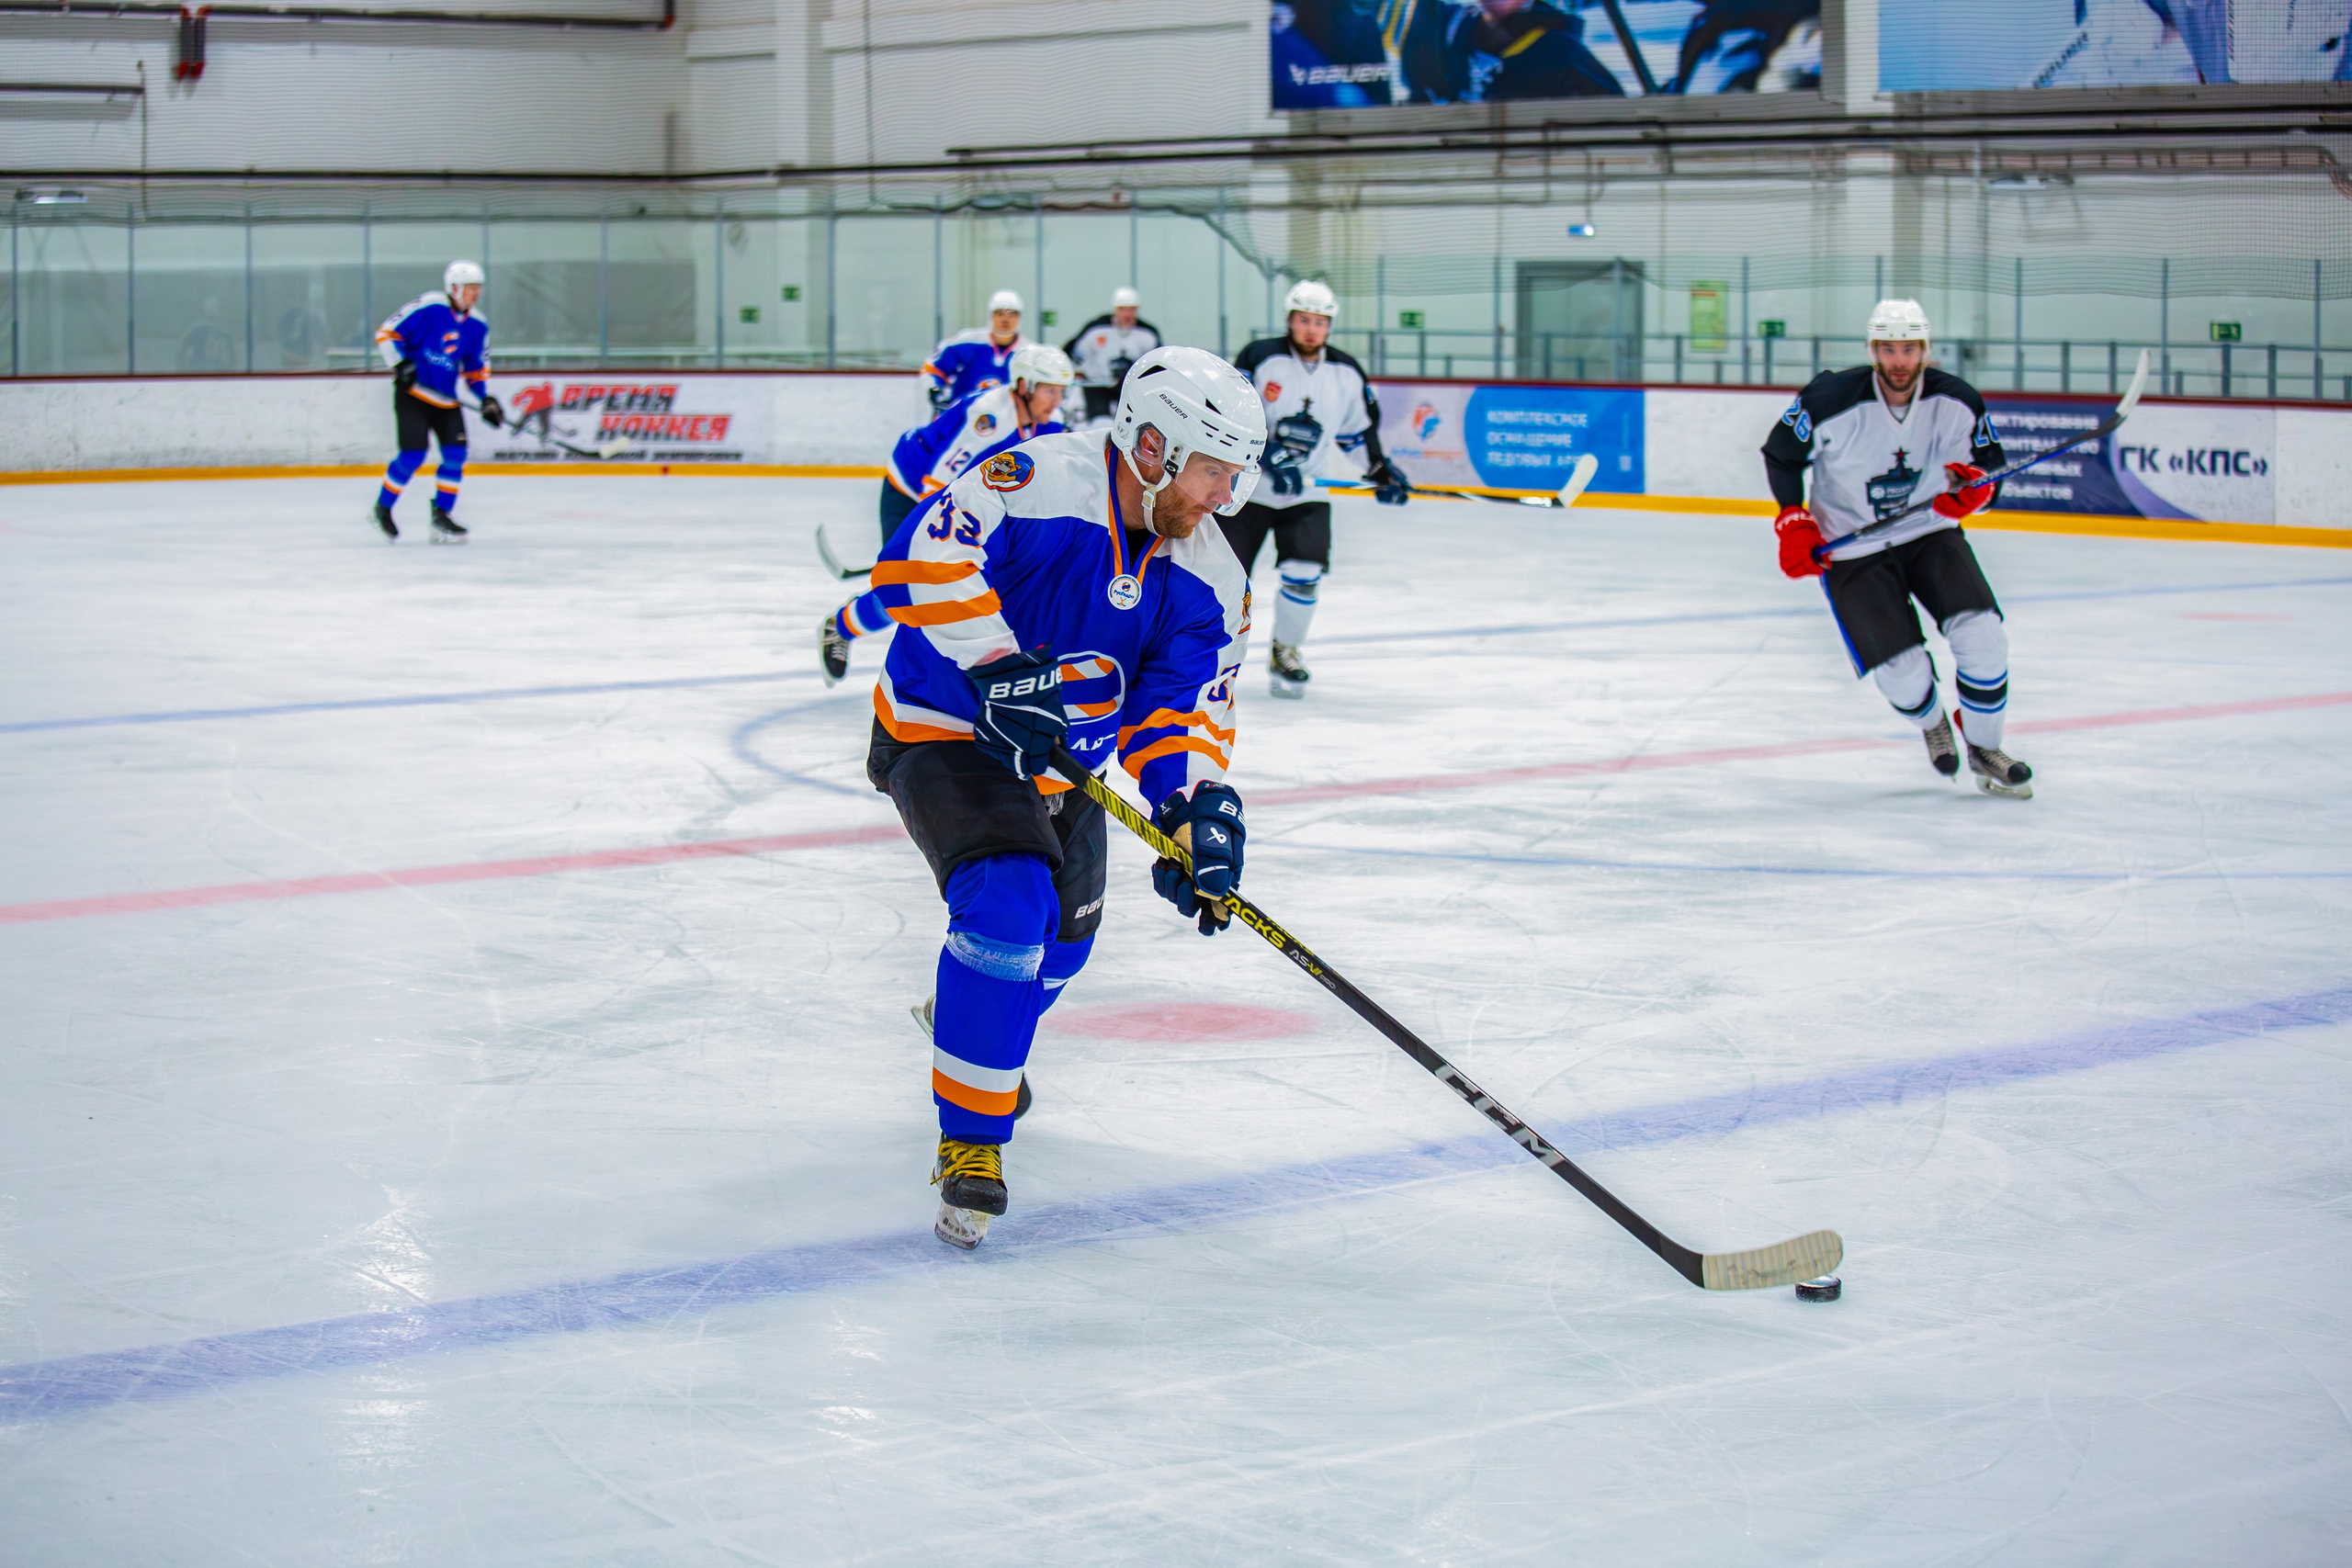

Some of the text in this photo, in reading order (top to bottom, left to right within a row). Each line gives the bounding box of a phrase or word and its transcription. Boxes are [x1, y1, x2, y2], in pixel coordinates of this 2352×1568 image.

[559, 384, 679, 412] ВРЕМЯ
[1159, 393, 1188, 420] BAUER
[596, 413, 731, 443] ХОККЕЯ
[1781, 395, 1814, 443] 26
[2118, 446, 2267, 477] ГК «КПС»
[926, 491, 982, 549] 33
[1434, 1063, 1566, 1168] CCM
